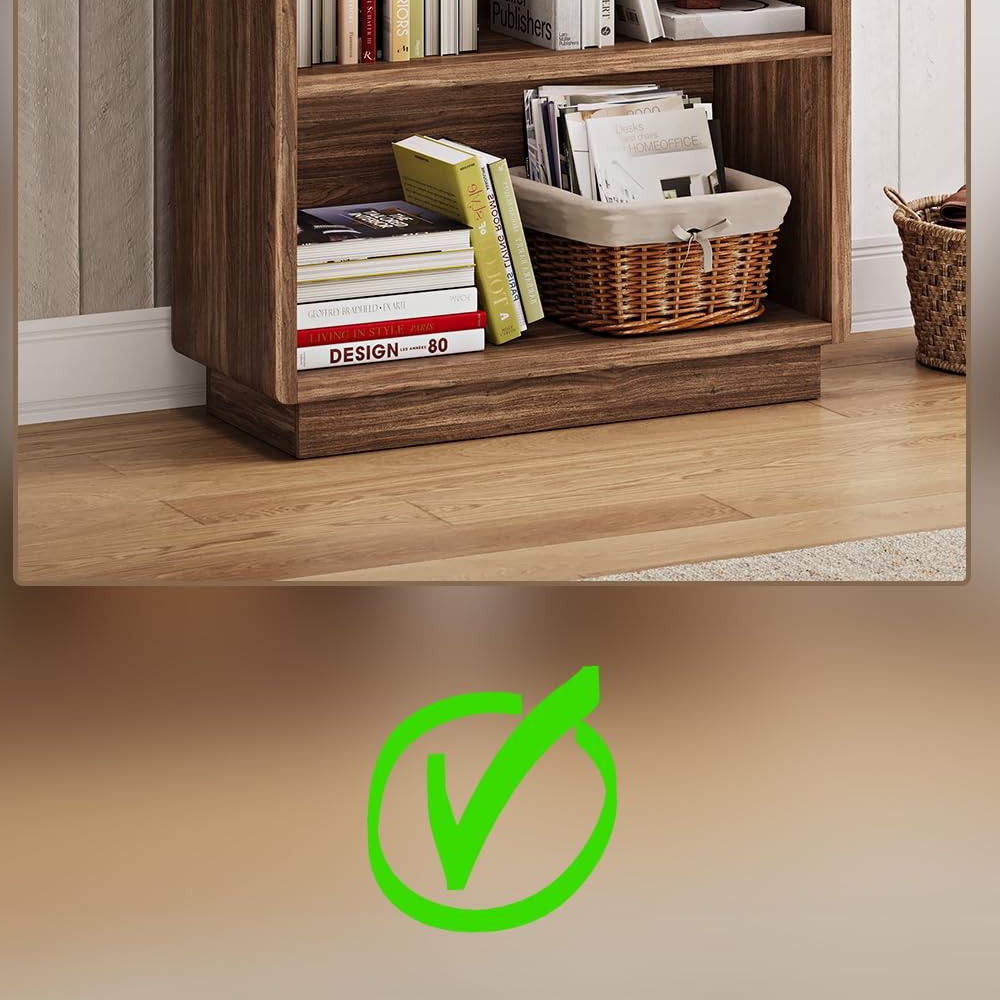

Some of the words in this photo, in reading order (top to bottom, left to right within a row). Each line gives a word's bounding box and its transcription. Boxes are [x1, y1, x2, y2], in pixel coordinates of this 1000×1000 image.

[492, 1, 552, 41] Publishers
[309, 329, 350, 342] LIVING
[353, 326, 366, 338] IN
[369, 322, 404, 337] STYLE
[329, 342, 399, 364] DESIGN
[428, 337, 448, 354] 80
